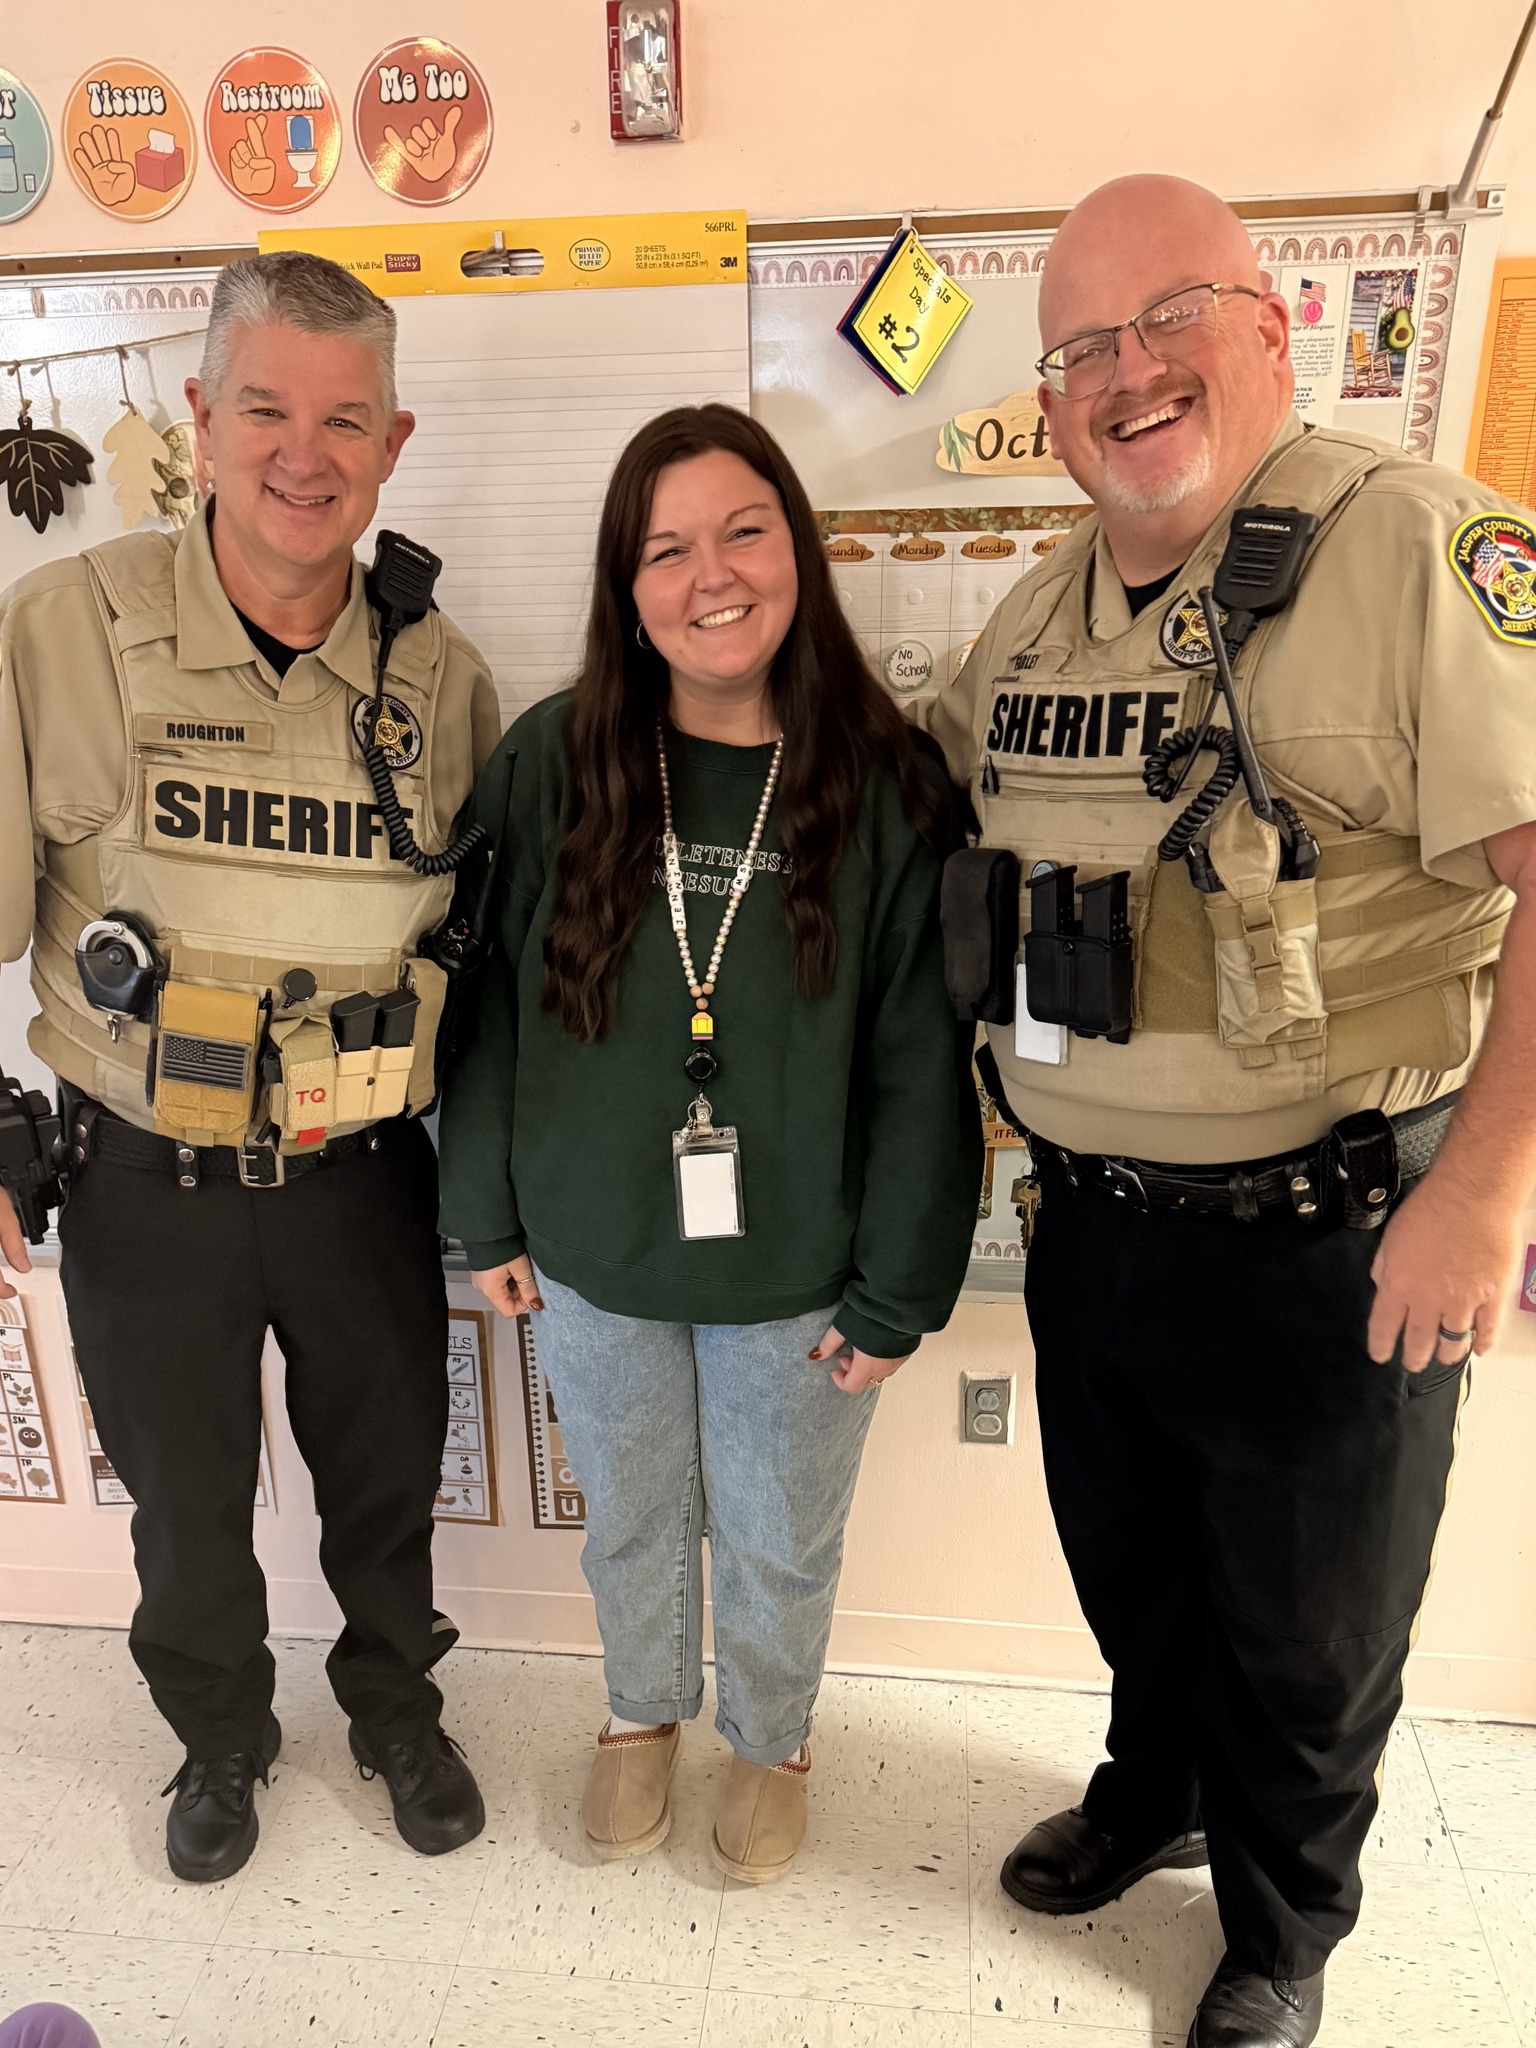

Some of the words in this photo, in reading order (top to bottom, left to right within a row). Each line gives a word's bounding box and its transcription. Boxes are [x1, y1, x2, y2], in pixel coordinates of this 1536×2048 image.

[608, 26, 622, 114] FIRE
[378, 65, 418, 103] Me
[424, 63, 470, 99] Too
[87, 81, 167, 117] Tissue
[219, 80, 325, 114] Restroom
[704, 222, 738, 233] 566PRL
[574, 246, 604, 254] PRIMARY
[643, 245, 667, 253] SHEETS
[635, 254, 643, 262] 20
[720, 257, 738, 268] 3M
[356, 262, 370, 270] Wall
[371, 261, 383, 269] Pad
[388, 261, 418, 270] Sticky
[913, 257, 952, 304] Specals
[975, 415, 1050, 461] Oct
[1243, 522, 1291, 532] MOTOROLA
[1036, 541, 1056, 552] Wed
[1458, 526, 1485, 563] JASPER
[1483, 521, 1532, 540] COUNTY
[394, 542, 430, 564] MOTOROLA
[826, 545, 866, 560] Sunday
[898, 544, 940, 558] Monday
[969, 542, 1013, 556] Tuesday
[1185, 642, 1203, 652] 1841
[899, 650, 913, 660] NO
[1197, 651, 1212, 661] OFF
[896, 662, 932, 677] School
[386, 699, 411, 718] COUNTY
[986, 691, 1180, 759] SHERIFF
[166, 722, 245, 742] ROUGHTON
[296, 1088, 326, 1106] TQ
[995, 1129, 1004, 1139] IT
[1005, 1129, 1018, 1138] FE
[3, 1373, 15, 1381] PL
[12, 1416, 26, 1424] SM
[21, 1459, 32, 1467] TR
